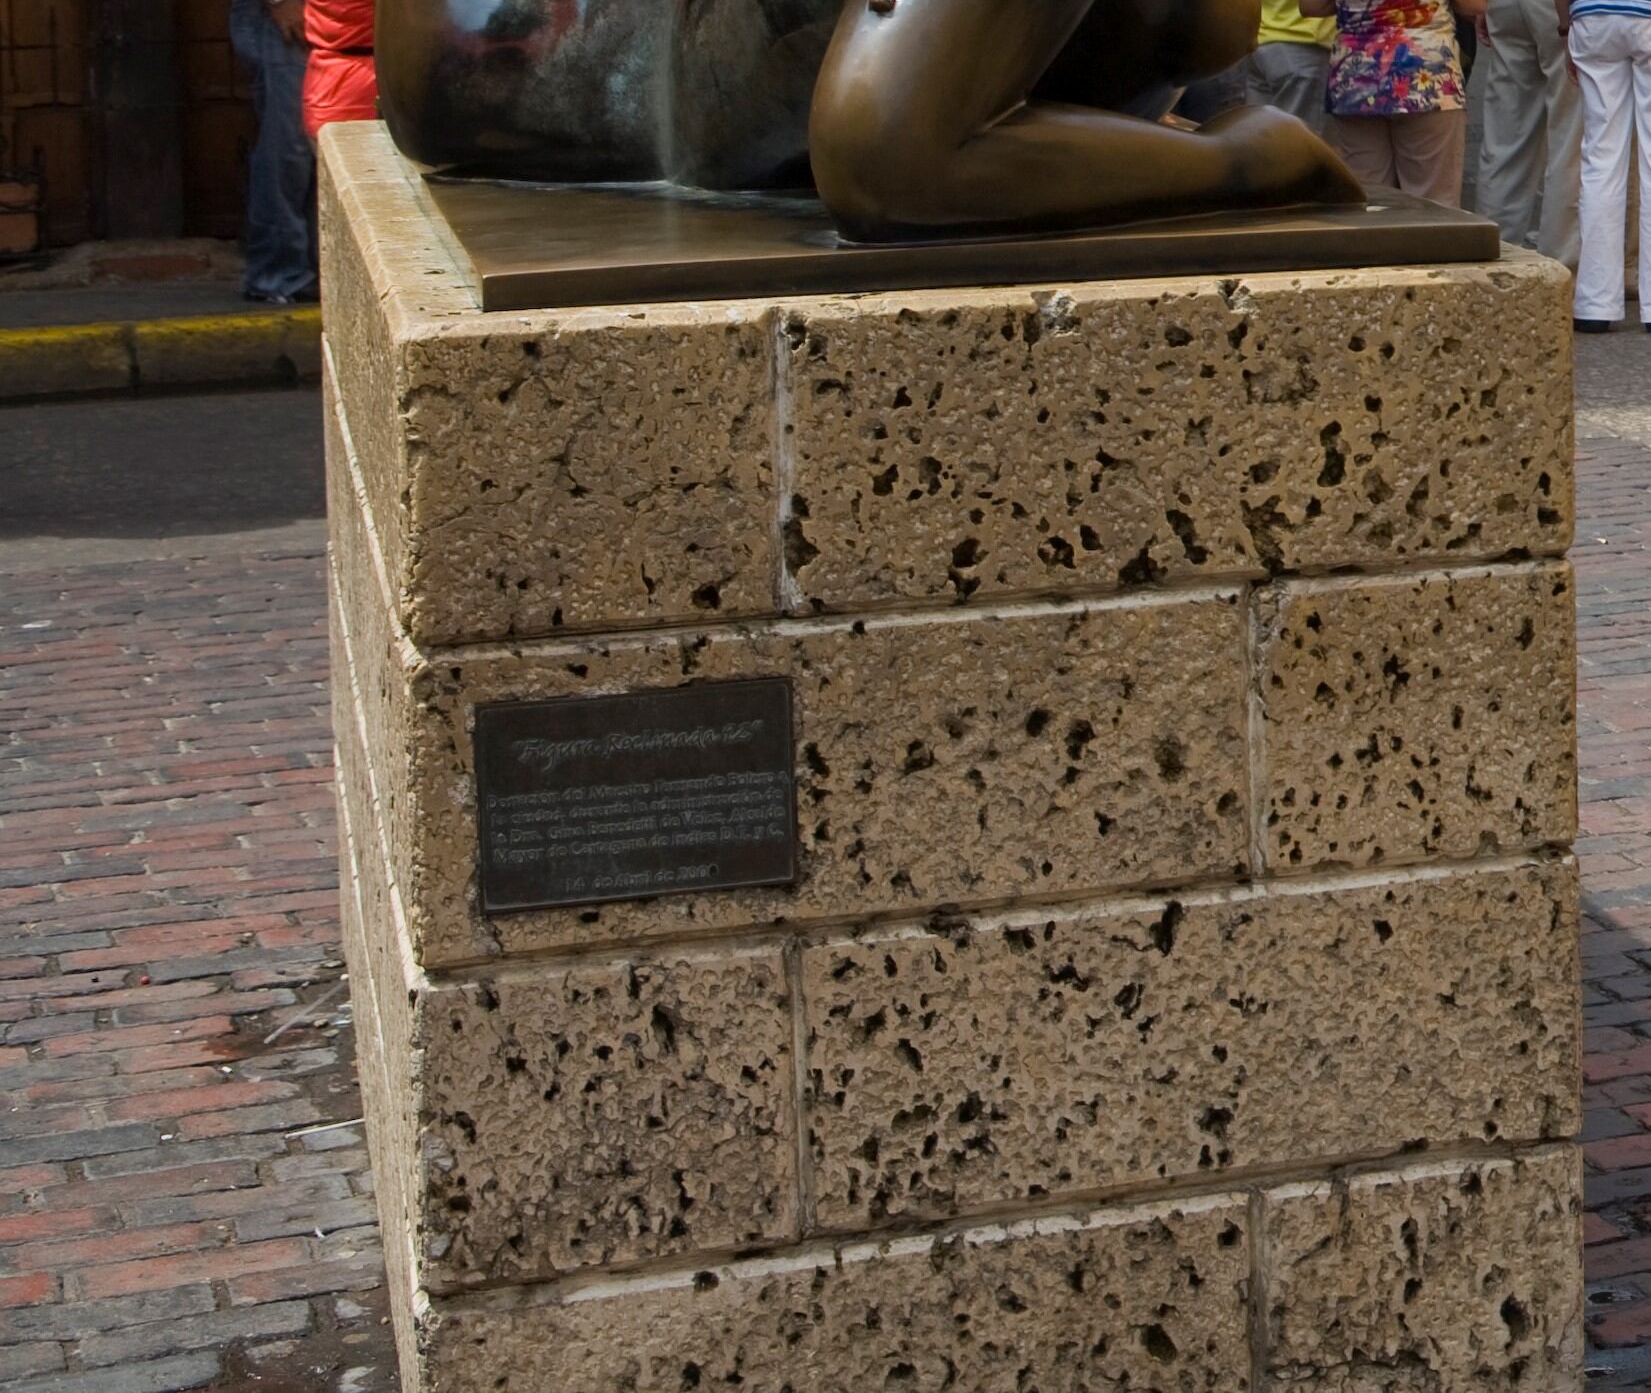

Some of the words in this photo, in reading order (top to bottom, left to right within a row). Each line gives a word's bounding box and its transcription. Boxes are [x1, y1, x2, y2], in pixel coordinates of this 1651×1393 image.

[560, 786, 585, 801] del
[587, 780, 651, 798] Maestro
[654, 773, 726, 792] Fernando
[727, 768, 775, 785] Botero
[632, 798, 648, 813] la
[763, 785, 783, 800] de
[659, 813, 680, 828] de
[493, 844, 545, 864] Mayor
[545, 842, 568, 857] de
[568, 834, 647, 858] Cartagena
[648, 832, 670, 847] de
[671, 828, 717, 846] Indias
[591, 874, 613, 887] de
[654, 867, 675, 881] de
